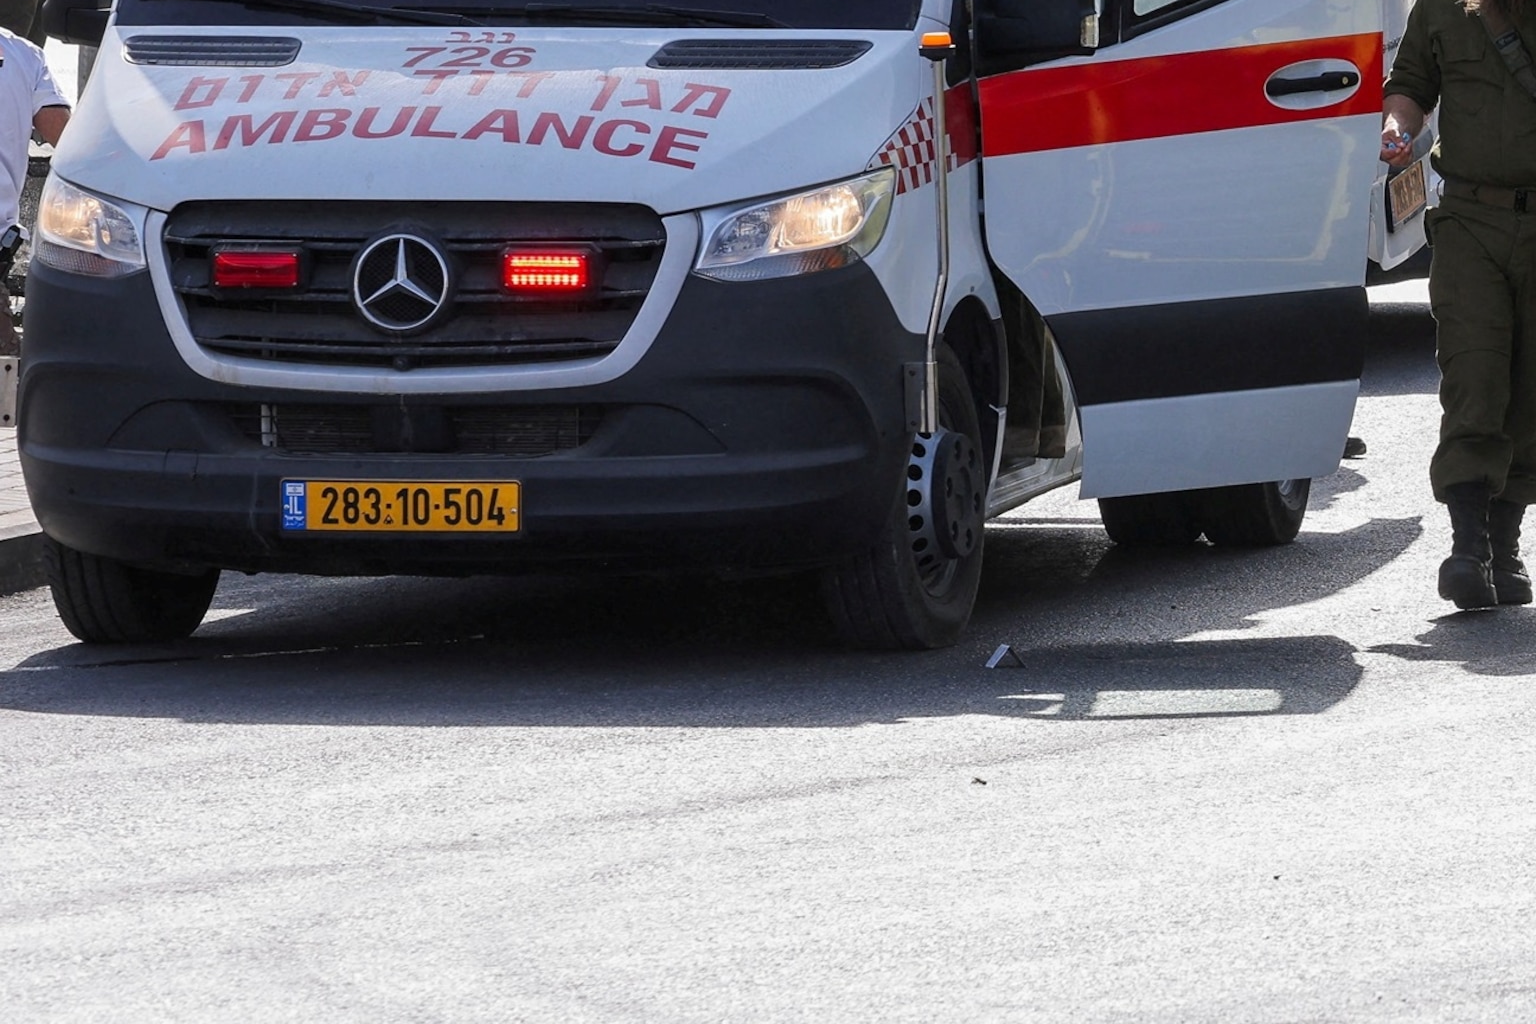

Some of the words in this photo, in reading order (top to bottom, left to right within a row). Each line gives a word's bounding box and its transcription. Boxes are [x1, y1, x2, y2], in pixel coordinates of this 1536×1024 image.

[444, 30, 516, 44] נגב
[404, 46, 537, 69] 726
[174, 69, 371, 111] אדום
[408, 69, 558, 100] דוד
[590, 72, 733, 120] מגן
[149, 105, 710, 171] AMBULANCE
[289, 495, 302, 515] IL
